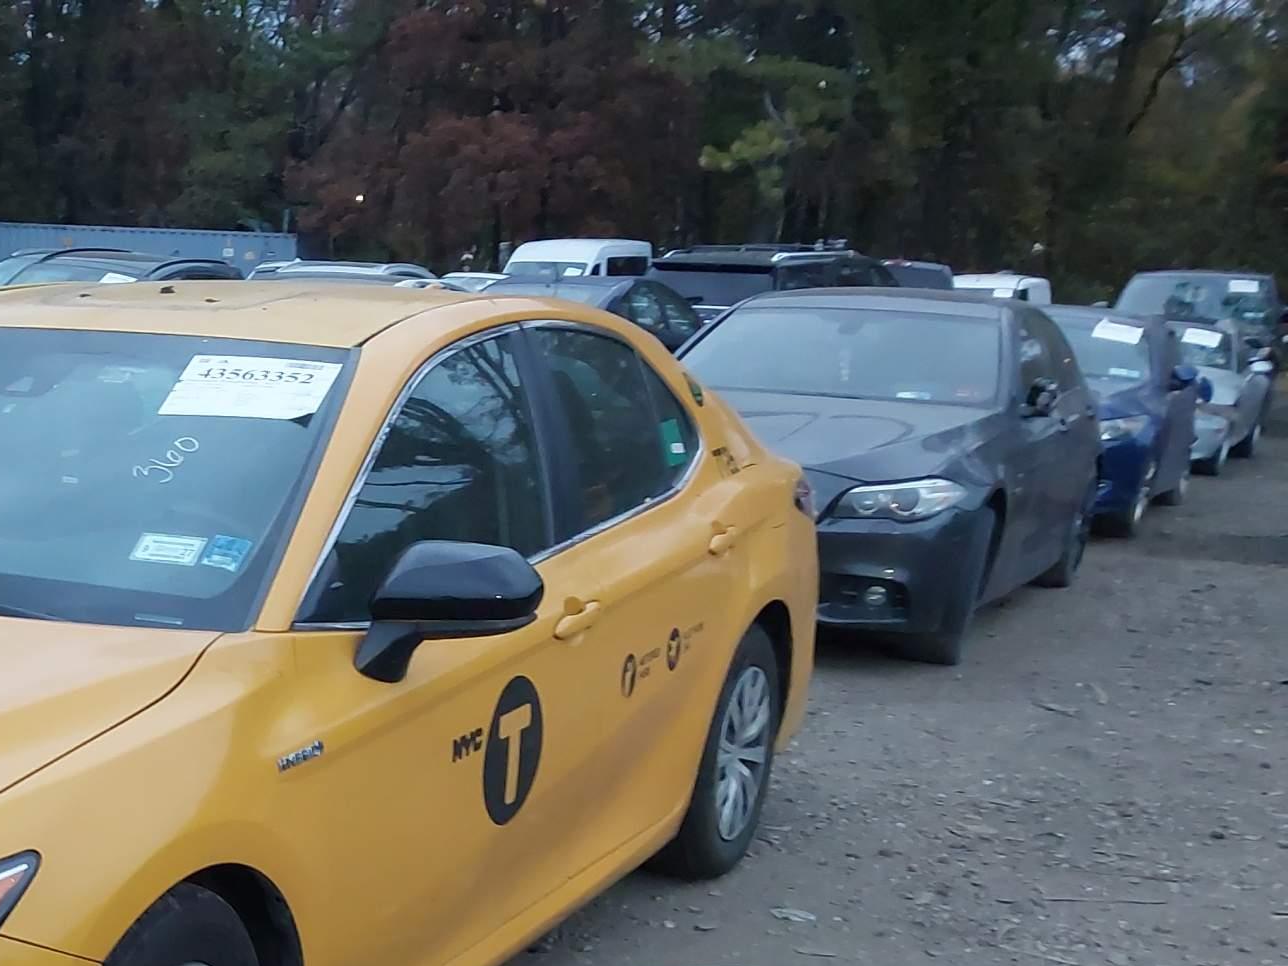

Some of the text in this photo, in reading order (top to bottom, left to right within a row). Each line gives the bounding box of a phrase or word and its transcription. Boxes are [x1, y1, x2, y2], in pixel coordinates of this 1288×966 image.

[197, 367, 315, 385] 43563352
[132, 436, 200, 484] 360
[452, 727, 483, 763] NYC
